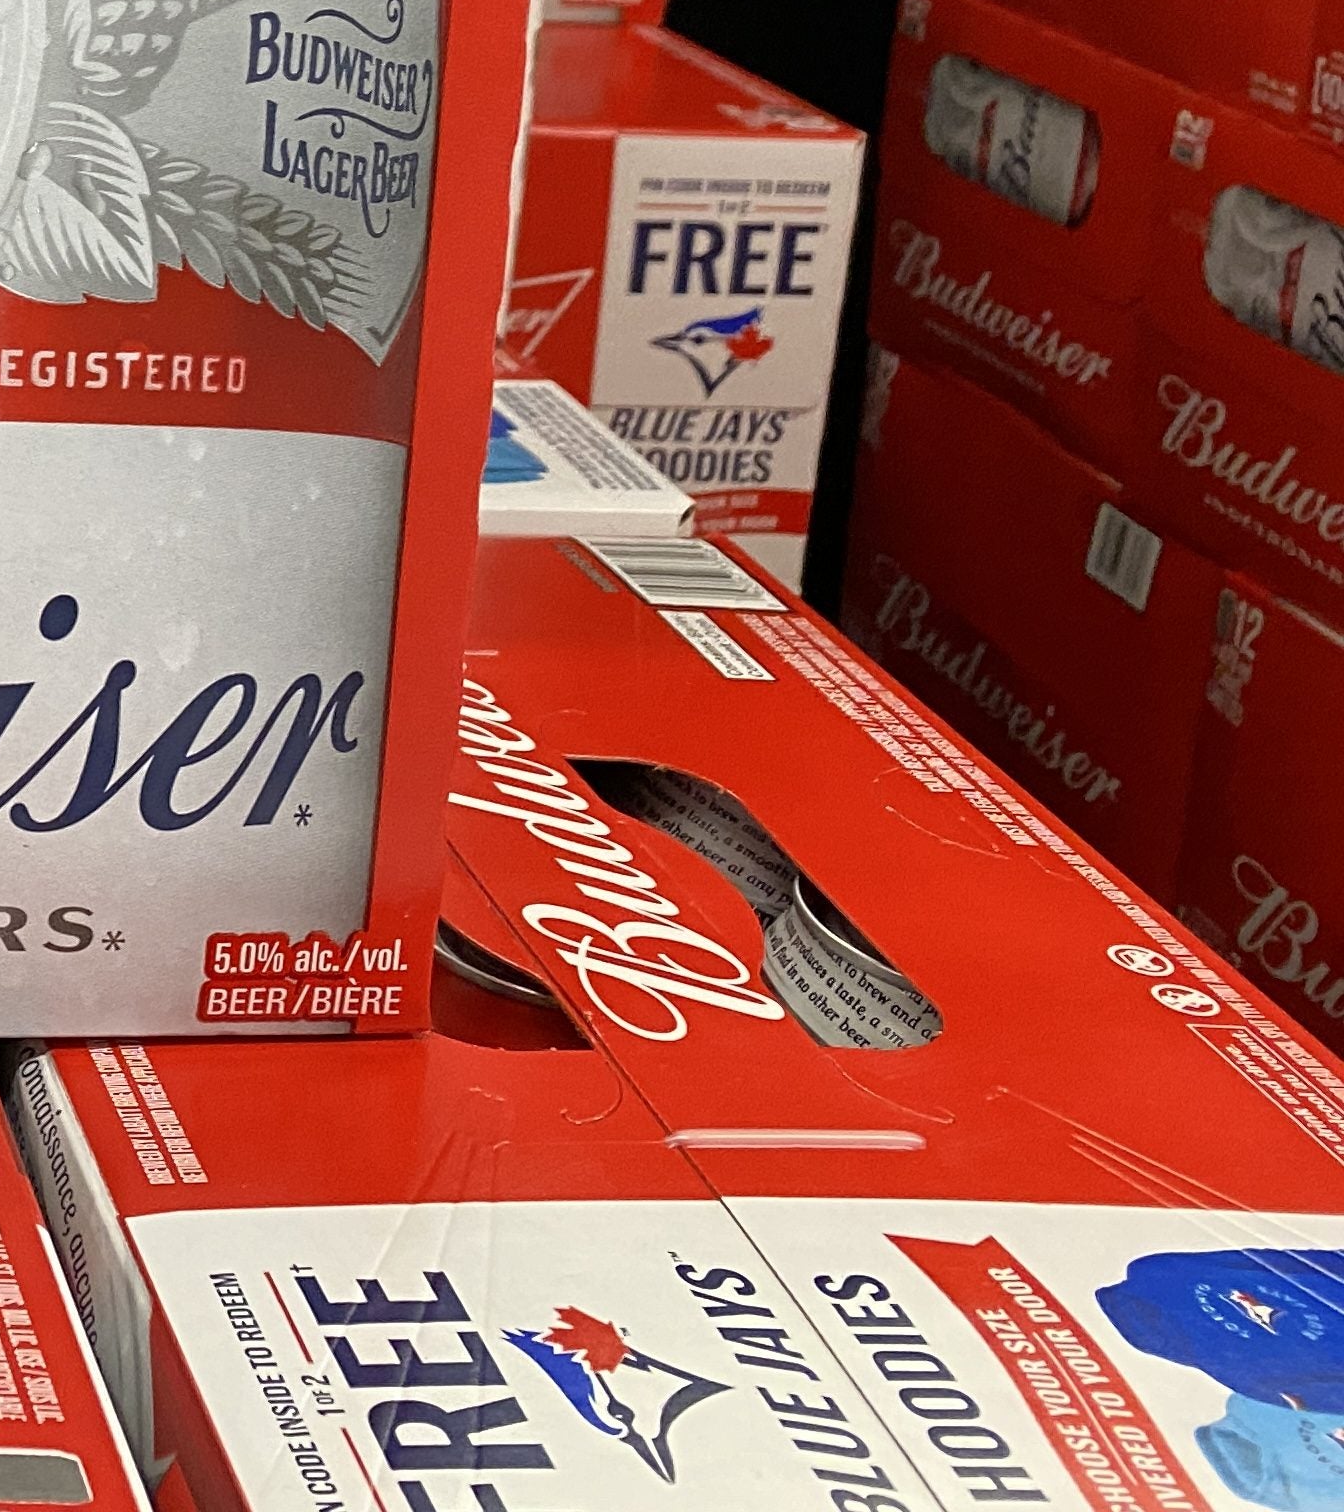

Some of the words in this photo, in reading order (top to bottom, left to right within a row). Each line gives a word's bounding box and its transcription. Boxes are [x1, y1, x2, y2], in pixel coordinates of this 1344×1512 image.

[628, 220, 819, 296] FREE
[890, 219, 1112, 385] Budweiser
[874, 552, 1123, 803] Budweiser
[213, 942, 284, 974] 5.0%
[209, 1272, 265, 1342] REDEEM
[244, 1346, 277, 1370] TO
[813, 1274, 1051, 1502] HOODIES
[256, 1374, 311, 1438] INSIDE
[288, 1441, 339, 1495] CODE
[756, 1386, 912, 1512] BLUE
